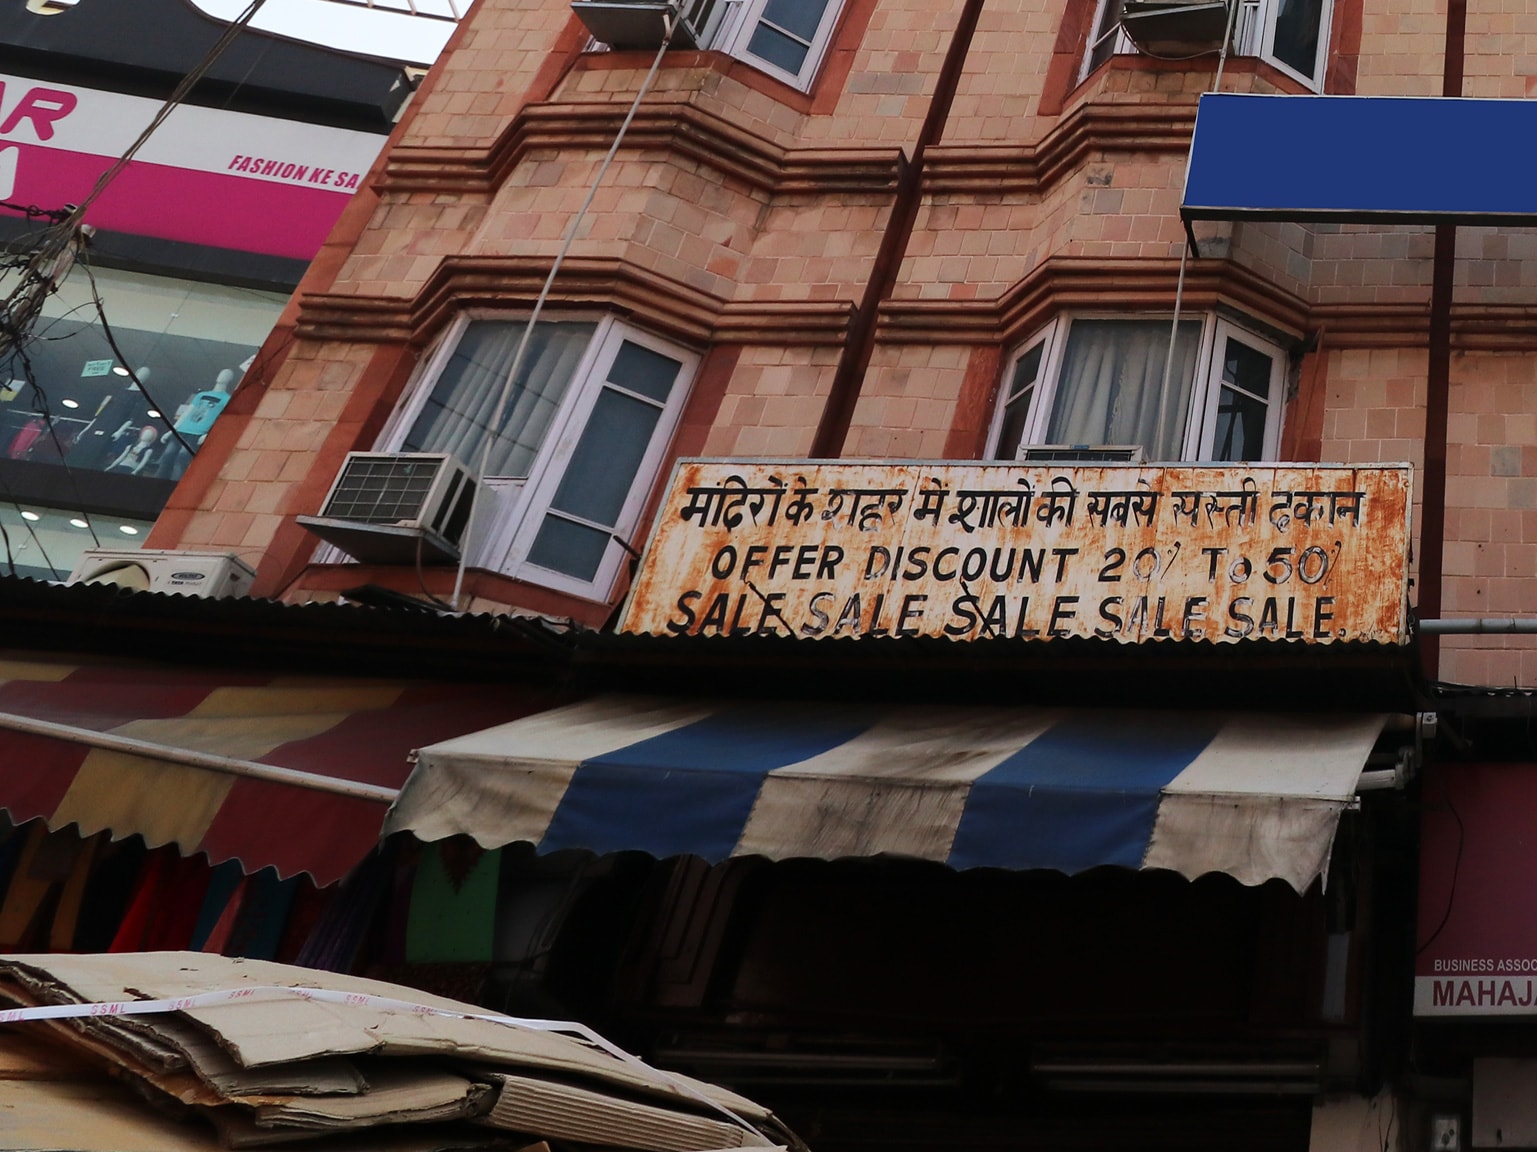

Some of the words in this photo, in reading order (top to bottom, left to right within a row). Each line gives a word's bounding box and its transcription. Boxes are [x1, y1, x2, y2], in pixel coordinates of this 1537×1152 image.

[0, 81, 77, 141] R
[227, 154, 309, 182] FASHION
[308, 167, 335, 185] KE
[821, 487, 908, 533] शहर
[1036, 476, 1080, 528] की
[1087, 478, 1164, 528] सबसे
[711, 545, 845, 581] OFFER
[863, 545, 1079, 583] DISCOUNT
[666, 591, 787, 637] SALE
[800, 592, 928, 638] SALE
[944, 594, 1080, 636] SALE
[1094, 596, 1211, 638] SALE
[1434, 959, 1494, 972] BUSINESS
[90, 1003, 126, 1015] SSML
